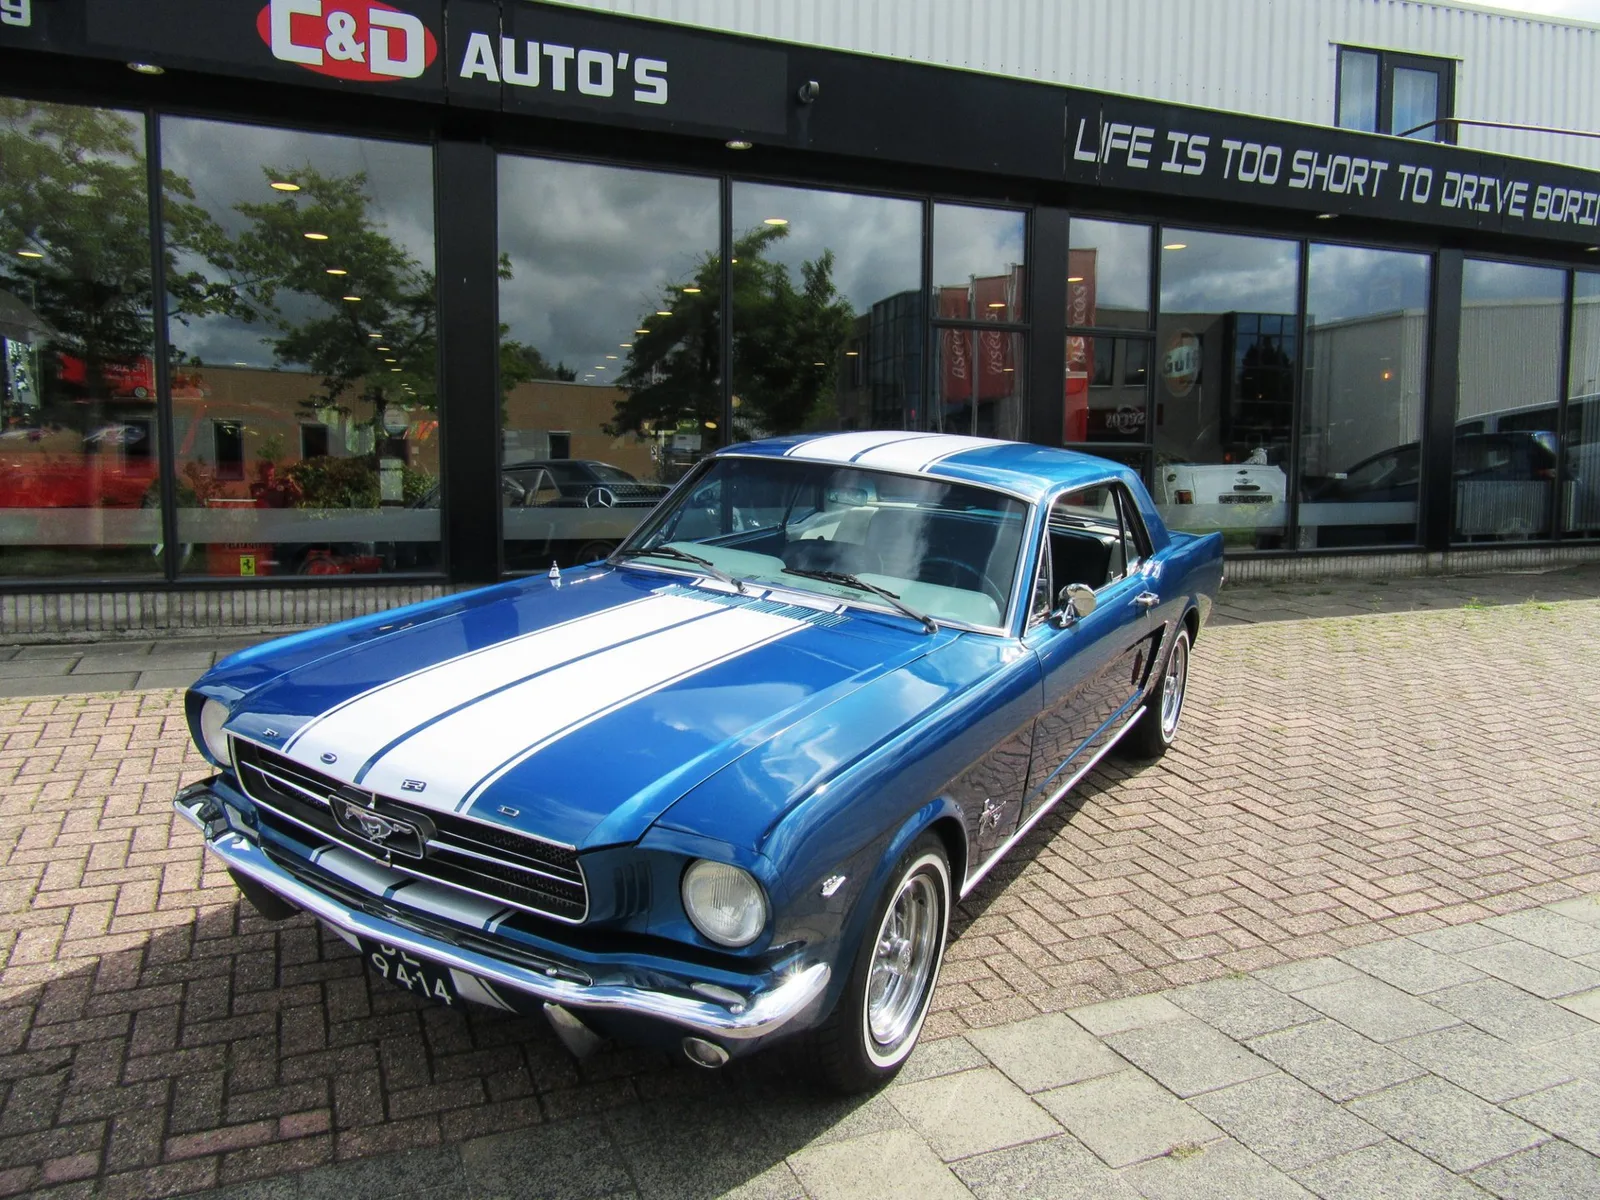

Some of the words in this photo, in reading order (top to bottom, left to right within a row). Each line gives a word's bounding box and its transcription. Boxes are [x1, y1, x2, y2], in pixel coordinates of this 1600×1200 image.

[271, 0, 425, 78] C&D
[460, 32, 668, 105] AUTO'S
[1073, 118, 1155, 169] LIFE
[1161, 131, 1210, 175] IS
[1221, 139, 1282, 185] TOO
[1288, 150, 1389, 198] SHORT
[1398, 164, 1433, 204] TO
[1440, 171, 1529, 221] DRIVE
